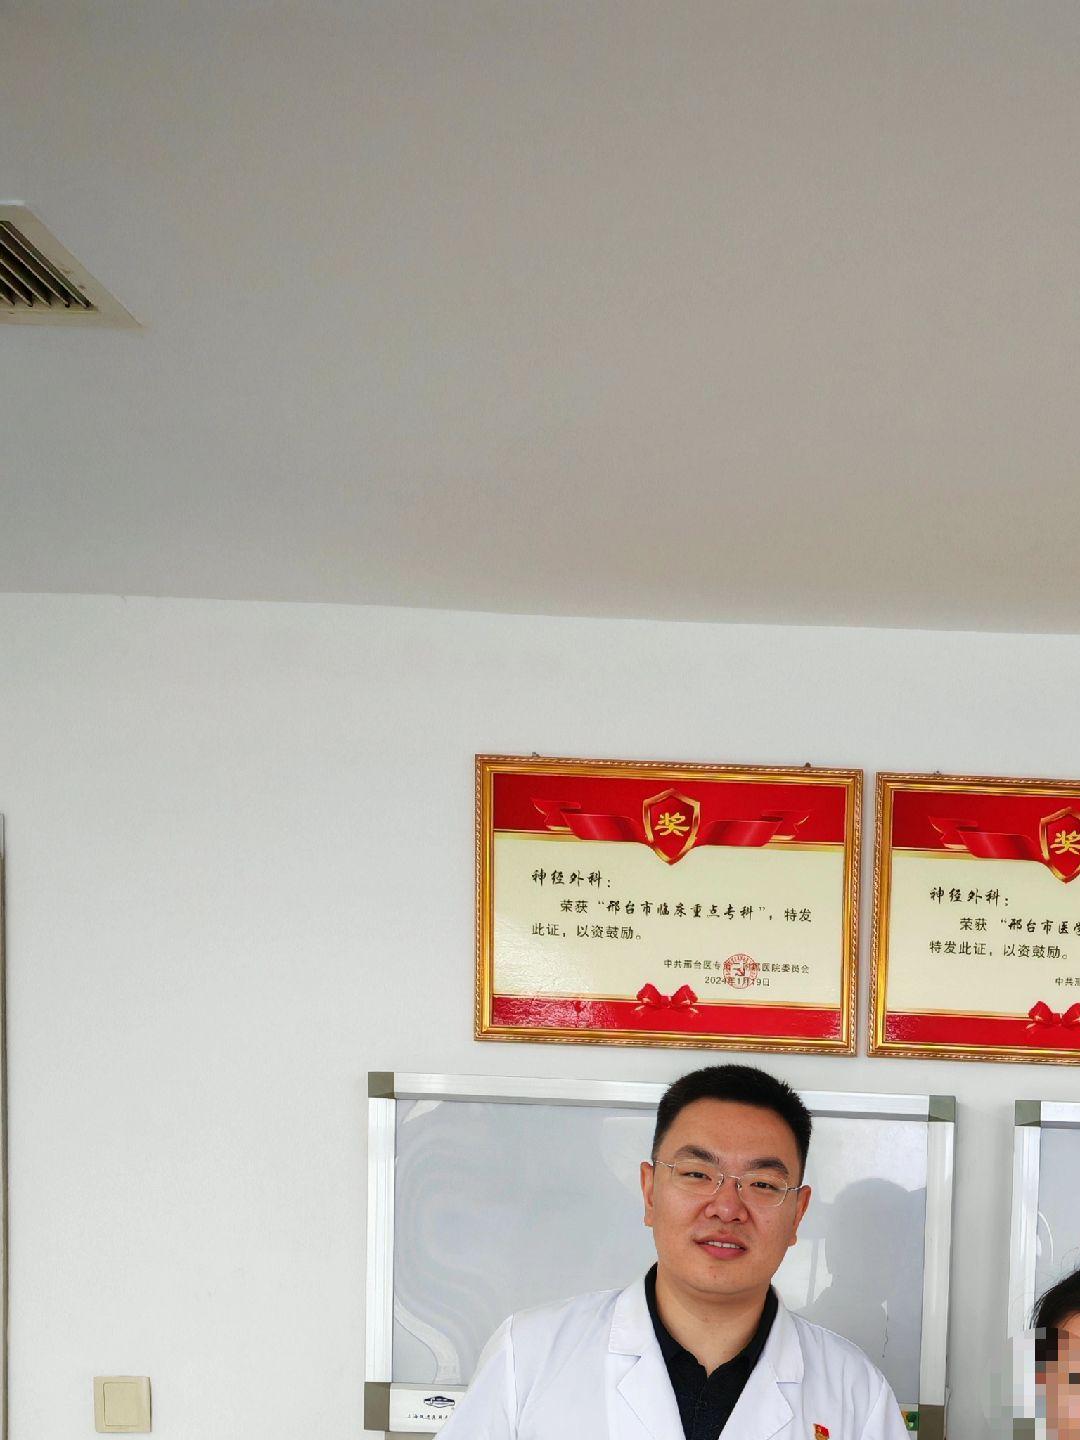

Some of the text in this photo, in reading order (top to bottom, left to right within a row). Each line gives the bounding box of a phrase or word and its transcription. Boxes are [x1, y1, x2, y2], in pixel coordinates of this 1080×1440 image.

[654, 812, 690, 837] 奖
[531, 868, 611, 889] 神经外科：
[929, 886, 1010, 907] 神经外科：
[531, 922, 643, 941] 此证，以资鼓励。
[929, 940, 1069, 960] 特发此证，以资鼓励。
